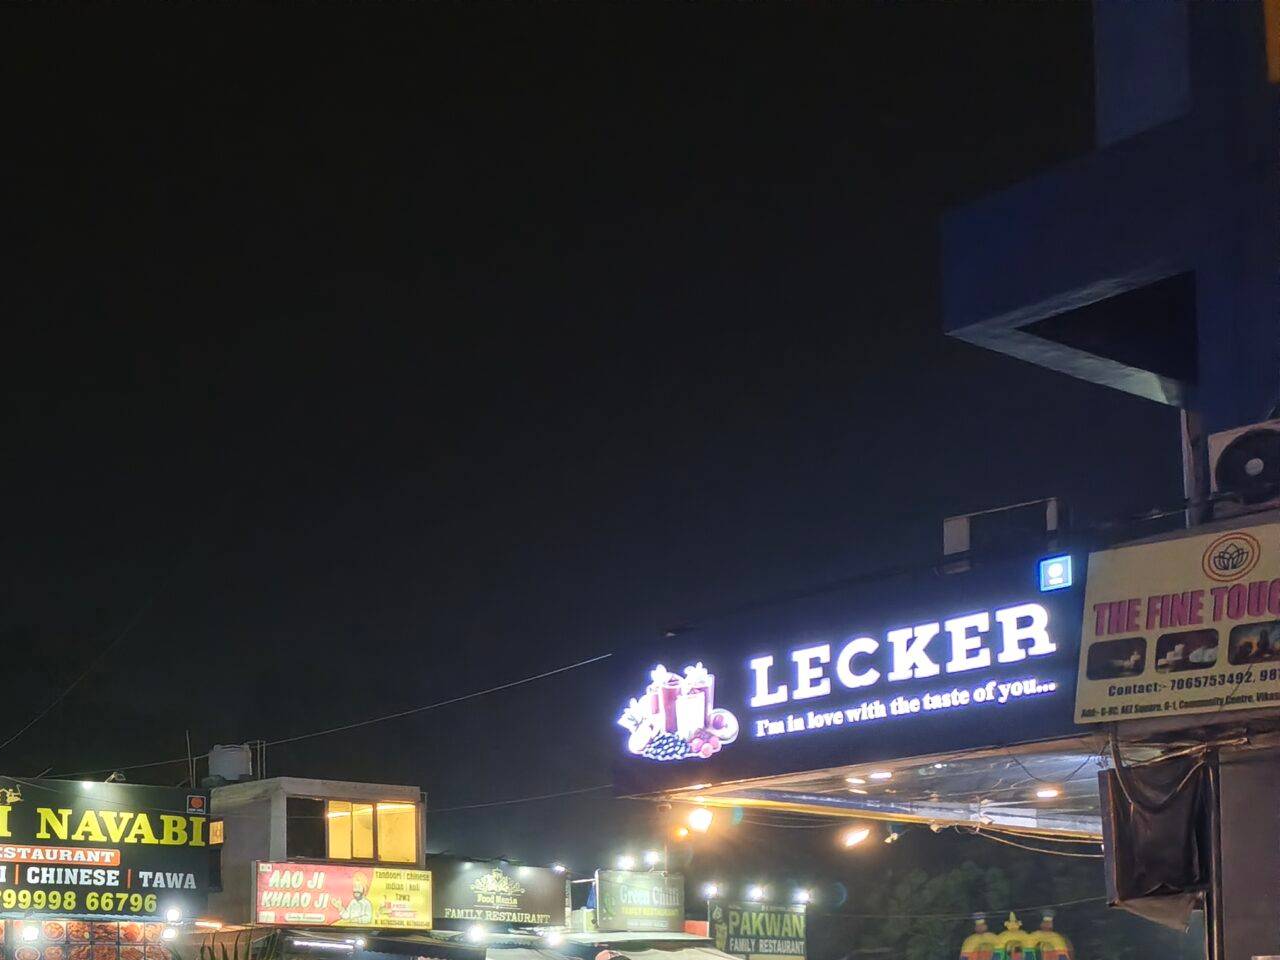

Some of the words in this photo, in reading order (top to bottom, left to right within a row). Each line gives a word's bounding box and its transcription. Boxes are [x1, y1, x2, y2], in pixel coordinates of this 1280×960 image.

[1093, 599, 1142, 637] THE
[1146, 589, 1204, 630] FINE
[750, 602, 1057, 708] LECKER
[756, 719, 785, 737] I'm
[787, 713, 804, 731] in
[808, 709, 844, 728] love
[846, 700, 887, 722] with
[890, 694, 920, 716] the
[923, 686, 971, 711] taste
[973, 681, 997, 703] of
[36, 807, 207, 847] NAVABI
[26, 866, 120, 887] CHINESE
[139, 871, 197, 890] TAWA
[269, 869, 304, 889] AAO
[307, 871, 326, 889] JI
[3, 890, 77, 911] 99998
[86, 892, 158, 913] 66796
[261, 890, 312, 909] KHAAO
[316, 892, 330, 910] JI
[477, 893, 495, 903] Food
[444, 908, 483, 919] FAMILY
[485, 910, 551, 924] RESTAURANT
[728, 910, 806, 939] PAKWAN
[729, 937, 756, 952] FAMILY
[758, 939, 806, 954] RESTAURANT
